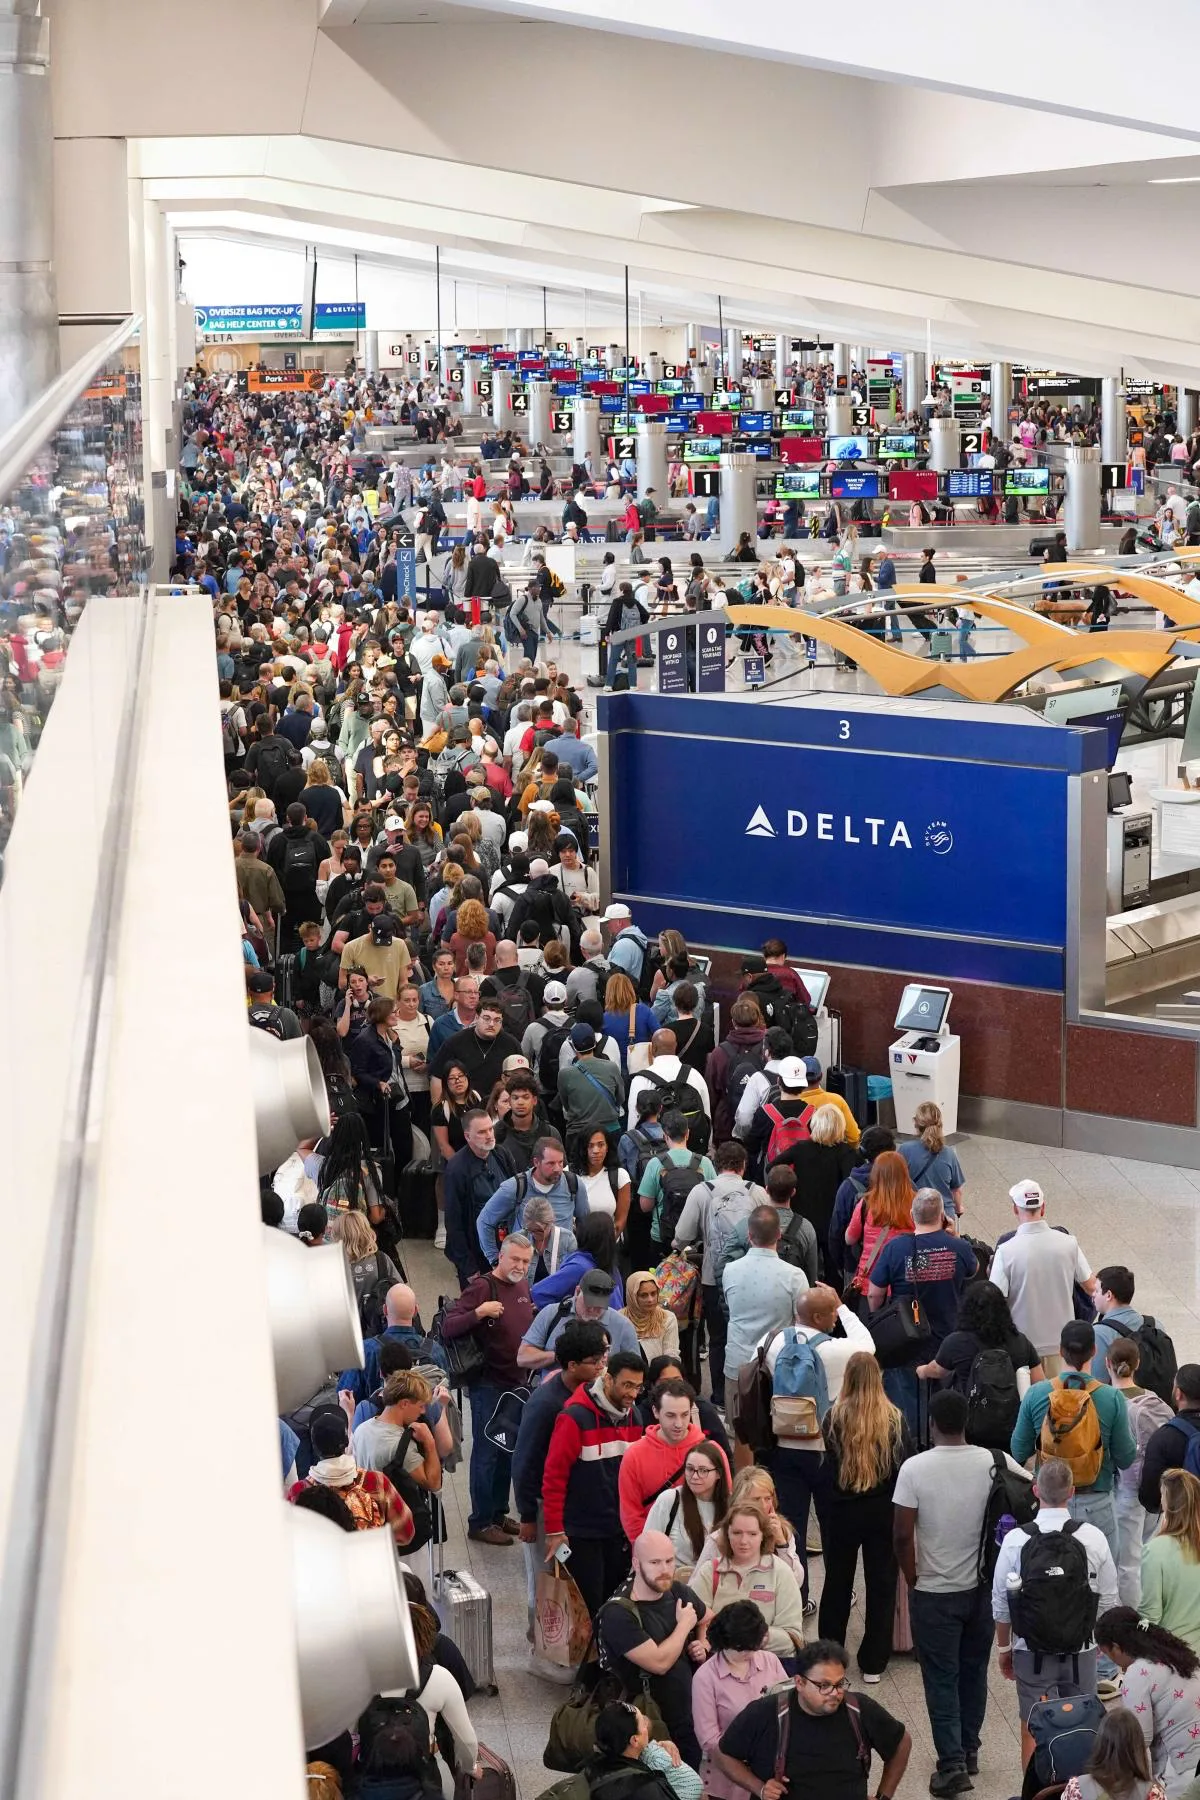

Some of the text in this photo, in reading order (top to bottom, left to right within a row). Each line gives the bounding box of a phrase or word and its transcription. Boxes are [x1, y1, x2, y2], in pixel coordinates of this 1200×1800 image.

[209, 307, 294, 316] OVERSIZE BAG PICK-UP
[209, 319, 276, 329] BAG HELP CENTER
[203, 334, 233, 343] ELTA
[393, 346, 401, 355] 9
[589, 350, 597, 359] 8
[410, 353, 418, 362] 8
[429, 361, 438, 371] 7
[665, 366, 675, 378] 6
[452, 371, 461, 381] 6
[480, 382, 490, 394] 5
[514, 396, 526, 408] 4
[777, 392, 789, 405] 4
[558, 414, 570, 429] 3
[856, 409, 867, 425] 3
[697, 424, 704, 433] 3
[619, 438, 633, 458] 2
[964, 434, 978, 452] 2
[781, 452, 789, 462] 2
[1110, 467, 1118, 487] 1
[702, 473, 711, 494] 1
[891, 487, 898, 499] 1
[669, 637, 675, 647] 2
[1049, 699, 1057, 709] 57
[839, 719, 851, 740] 3
[787, 809, 912, 849] DELTA
